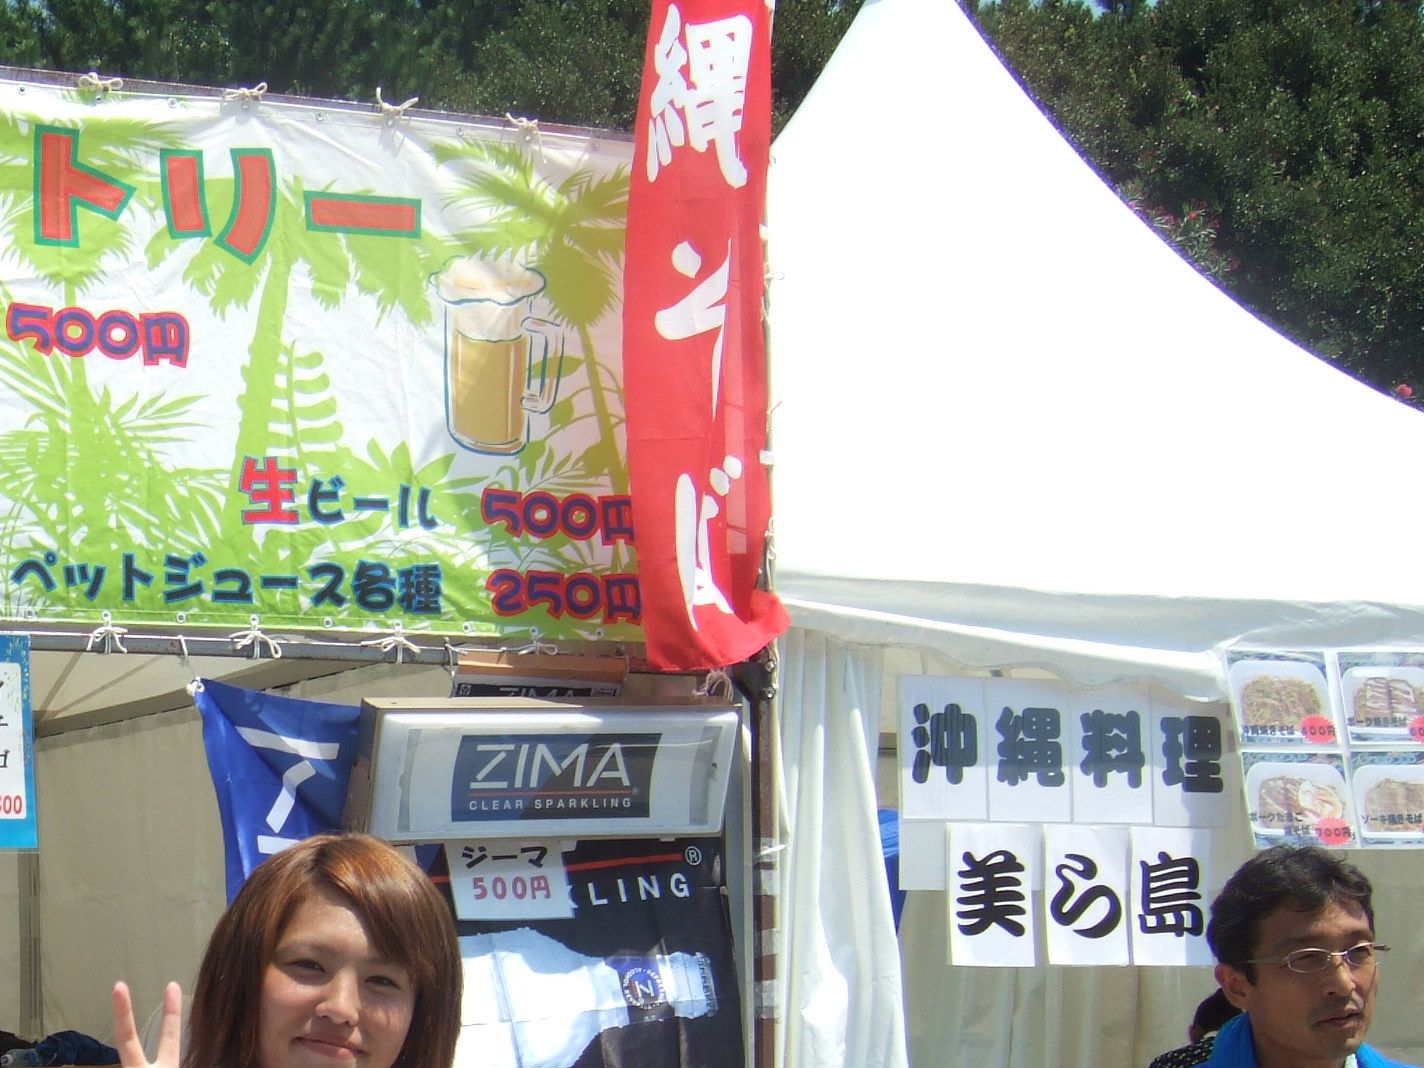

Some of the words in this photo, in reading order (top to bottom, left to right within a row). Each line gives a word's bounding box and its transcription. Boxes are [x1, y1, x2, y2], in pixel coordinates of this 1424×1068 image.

[6, 301, 189, 369] 500円
[239, 456, 438, 531] 生ビール
[12, 550, 443, 616] ペットジュース各種
[484, 567, 644, 624] 250円
[469, 742, 632, 790] ZIMA
[911, 702, 1226, 794] 沖縄料理
[468, 798, 524, 812] CLEAR
[533, 796, 632, 811] SPARKLING
[461, 845, 548, 869] ジーマ
[472, 874, 551, 901] 500円
[956, 848, 1205, 939] 美ら島
